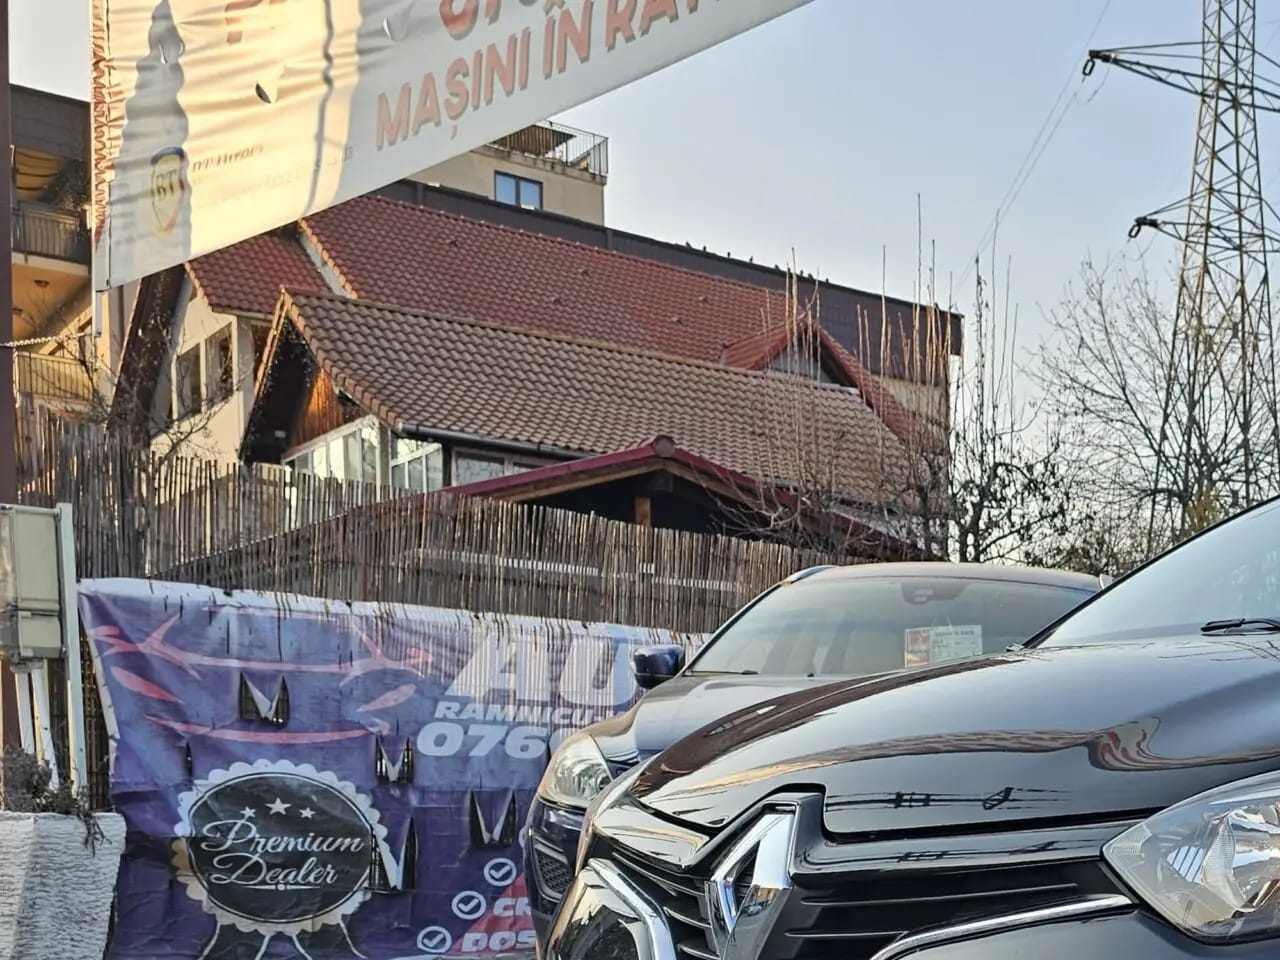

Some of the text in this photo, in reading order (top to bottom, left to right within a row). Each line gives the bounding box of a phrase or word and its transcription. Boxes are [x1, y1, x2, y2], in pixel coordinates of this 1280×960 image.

[376, 27, 532, 152] MAȘINI
[200, 818, 365, 854] Premium
[209, 852, 338, 884] Dealer
